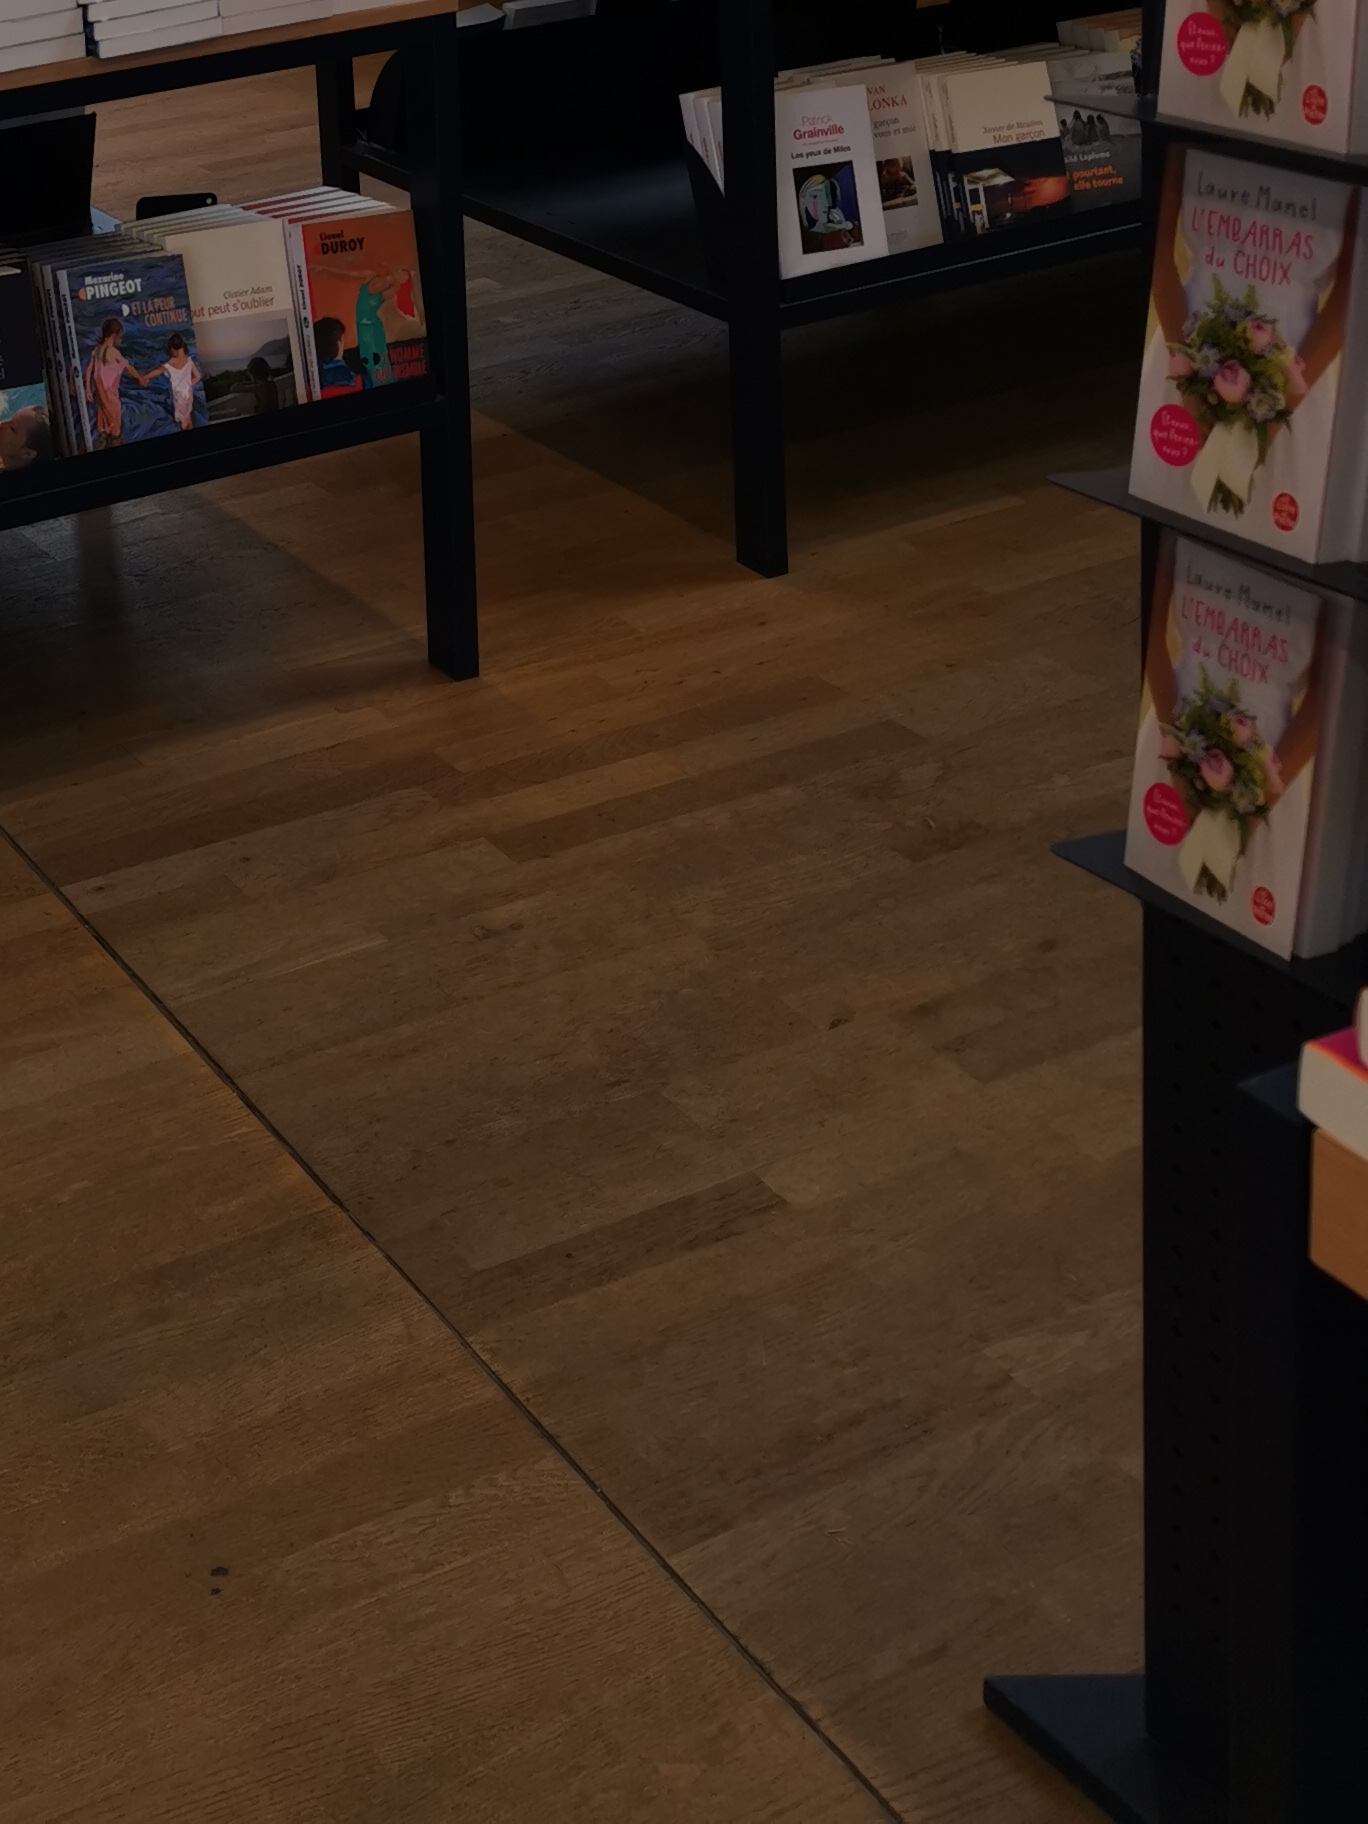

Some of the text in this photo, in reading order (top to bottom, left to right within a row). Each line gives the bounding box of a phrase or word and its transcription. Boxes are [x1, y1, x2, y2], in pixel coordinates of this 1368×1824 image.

[793, 125, 844, 140] Grainville
[1191, 207, 1314, 261] L'EMBARRAS
[320, 237, 365, 256] DUROY
[1205, 248, 1292, 287] du CHOIX
[86, 278, 142, 300] PINGEOT
